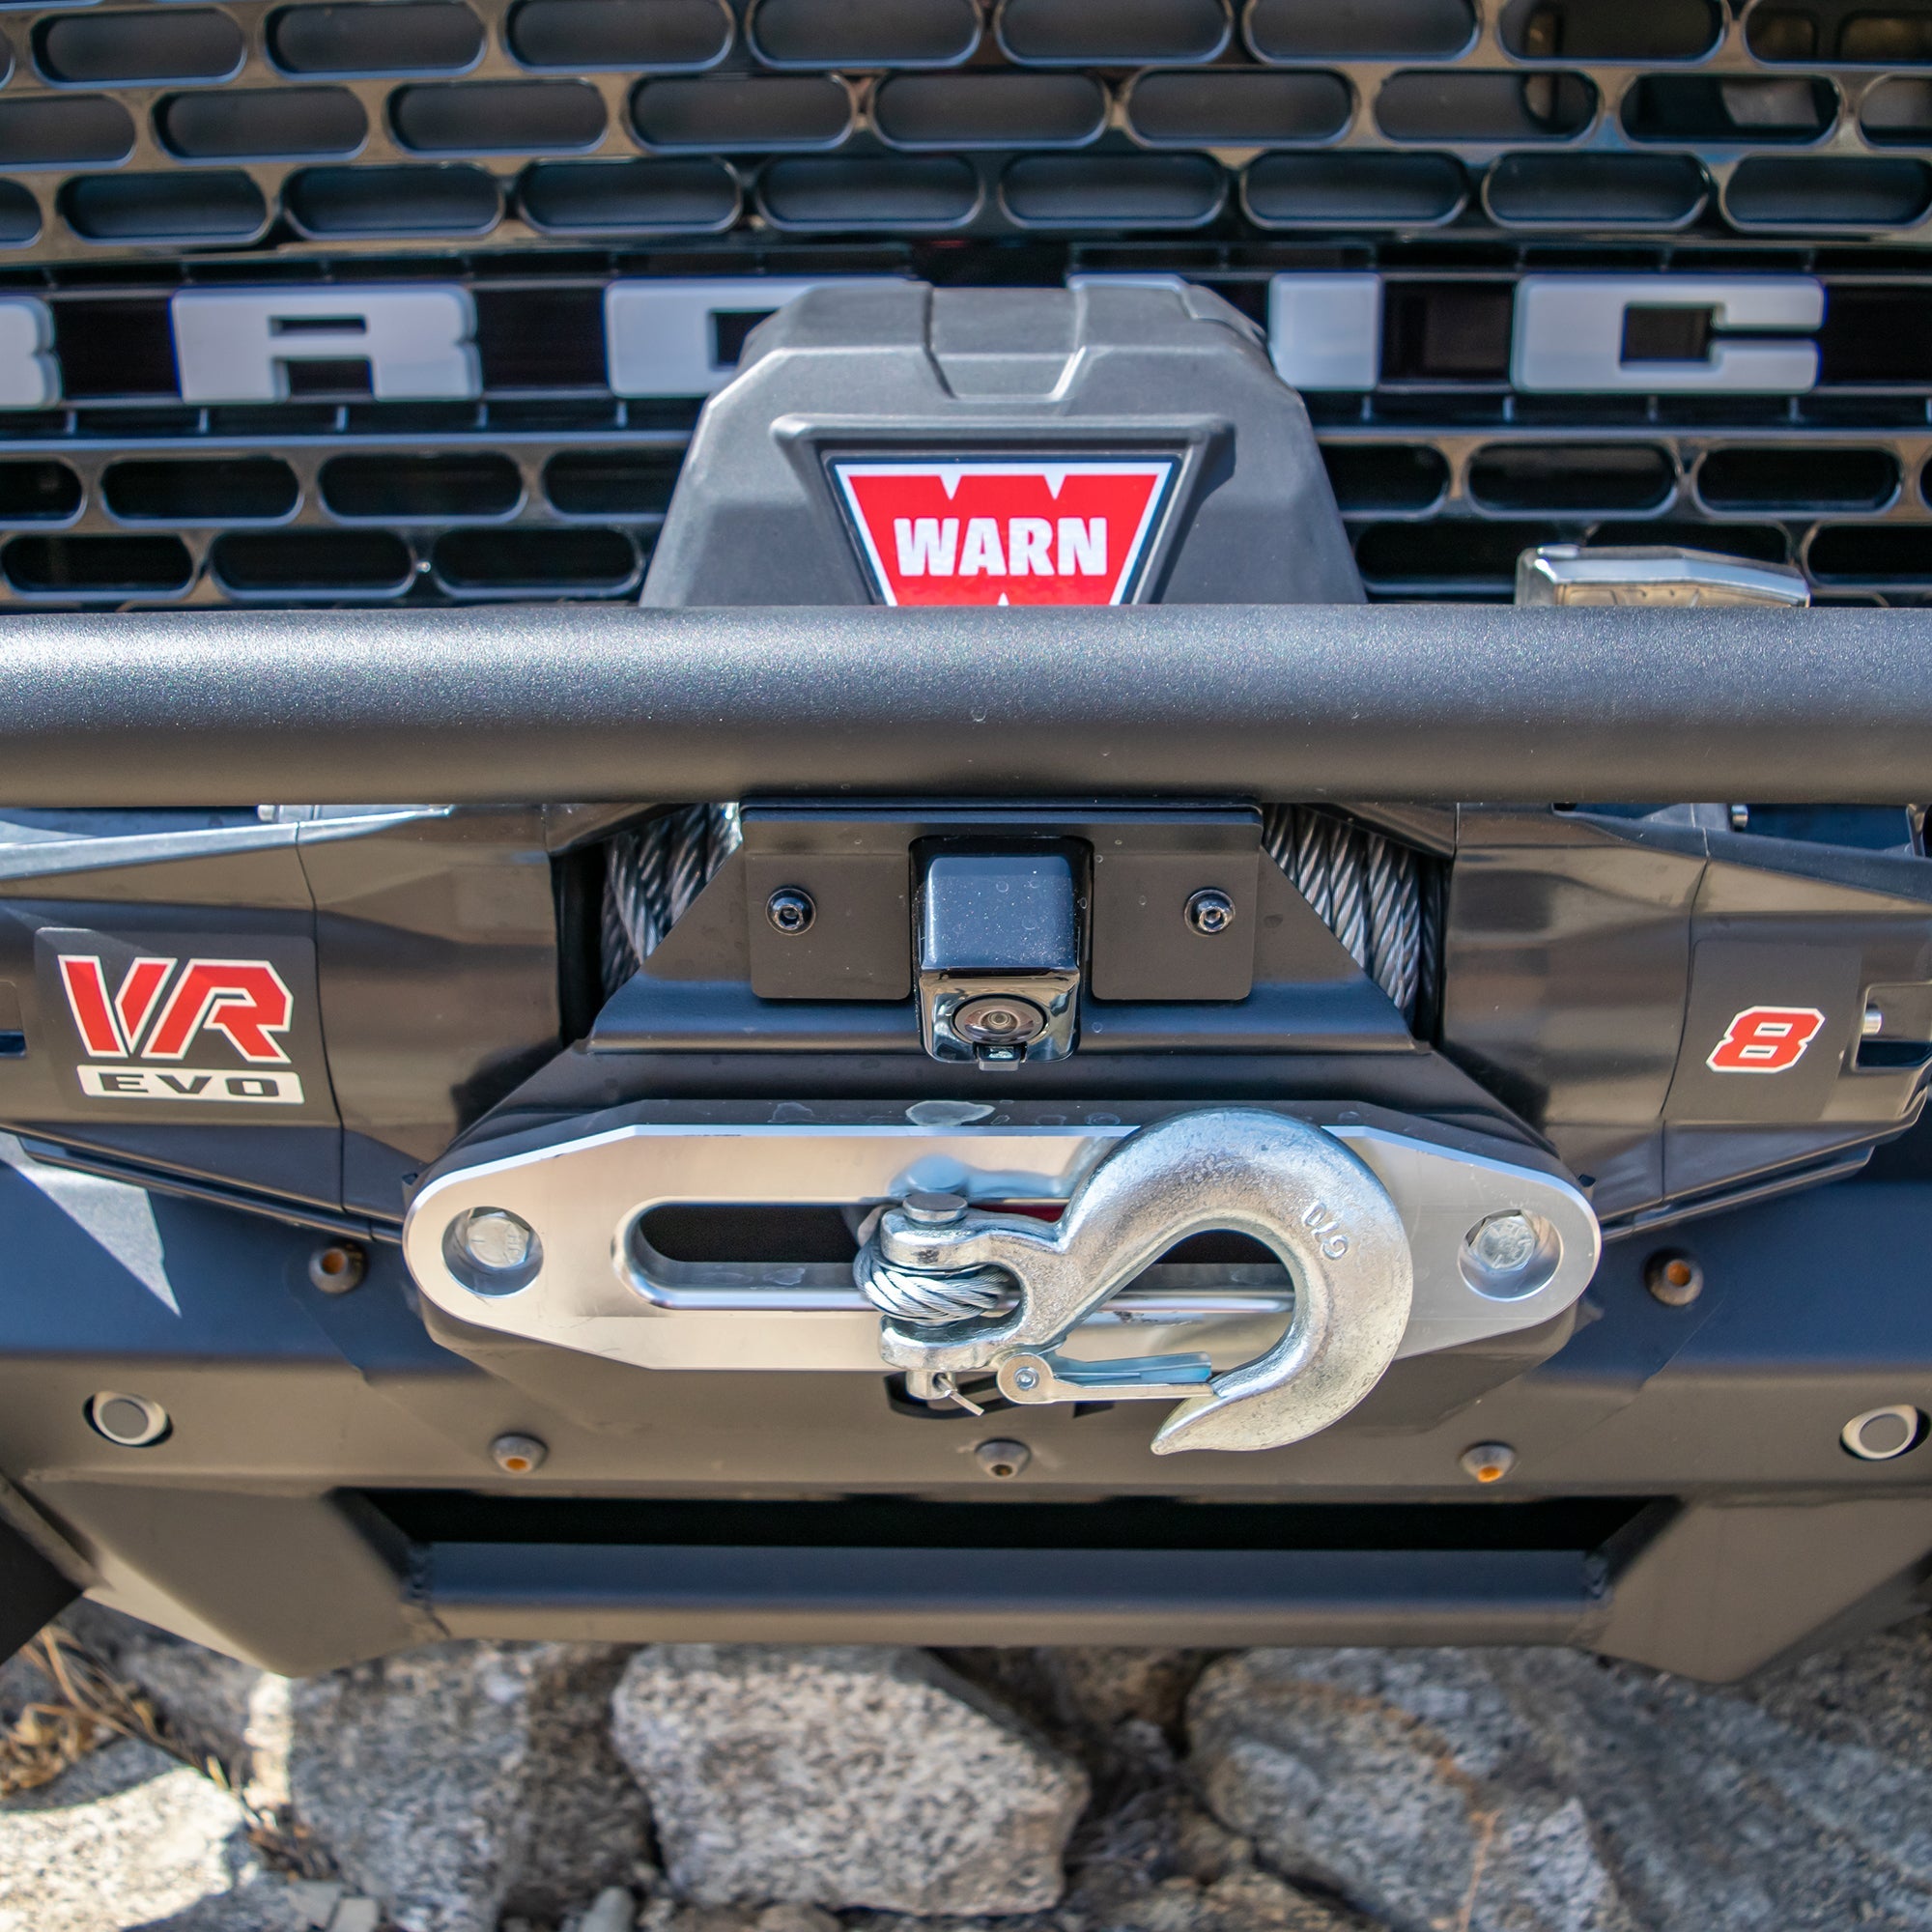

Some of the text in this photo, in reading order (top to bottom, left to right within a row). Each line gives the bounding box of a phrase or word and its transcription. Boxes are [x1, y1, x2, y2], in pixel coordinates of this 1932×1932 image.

[894, 517, 1107, 577] WARN
[57, 954, 294, 1064] VR
[1706, 1006, 1826, 1073] 8
[95, 1070, 282, 1099] EVO
